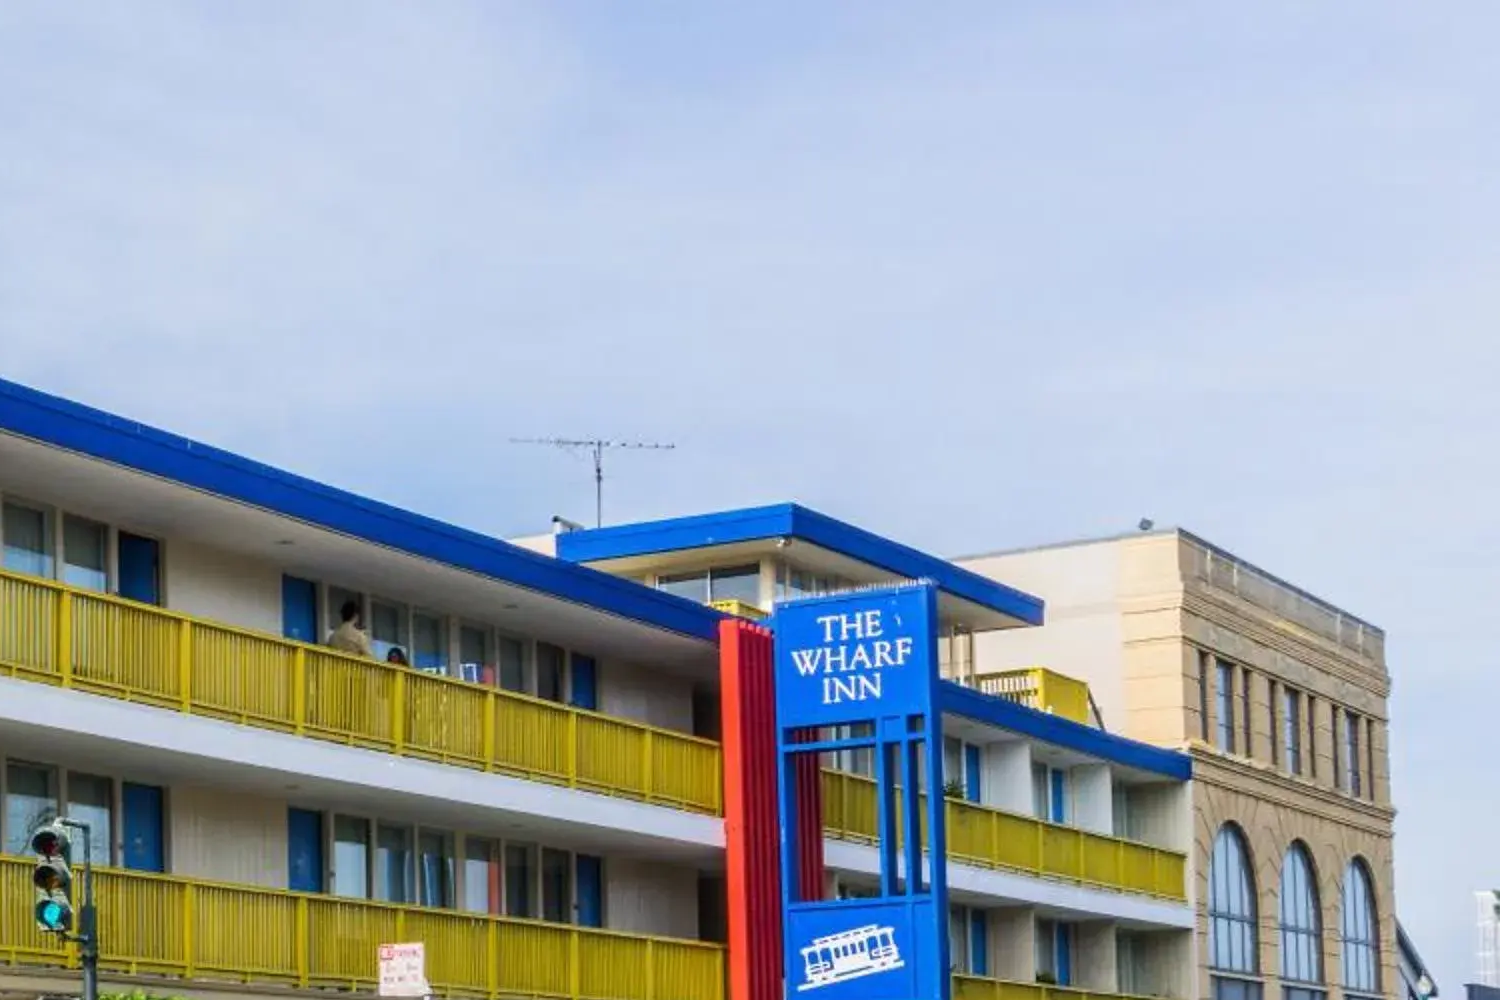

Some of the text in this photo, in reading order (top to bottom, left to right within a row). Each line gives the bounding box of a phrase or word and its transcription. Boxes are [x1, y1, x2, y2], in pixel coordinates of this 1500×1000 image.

[816, 609, 884, 642] THE
[791, 637, 913, 677] WHARF
[822, 672, 881, 704] INN
